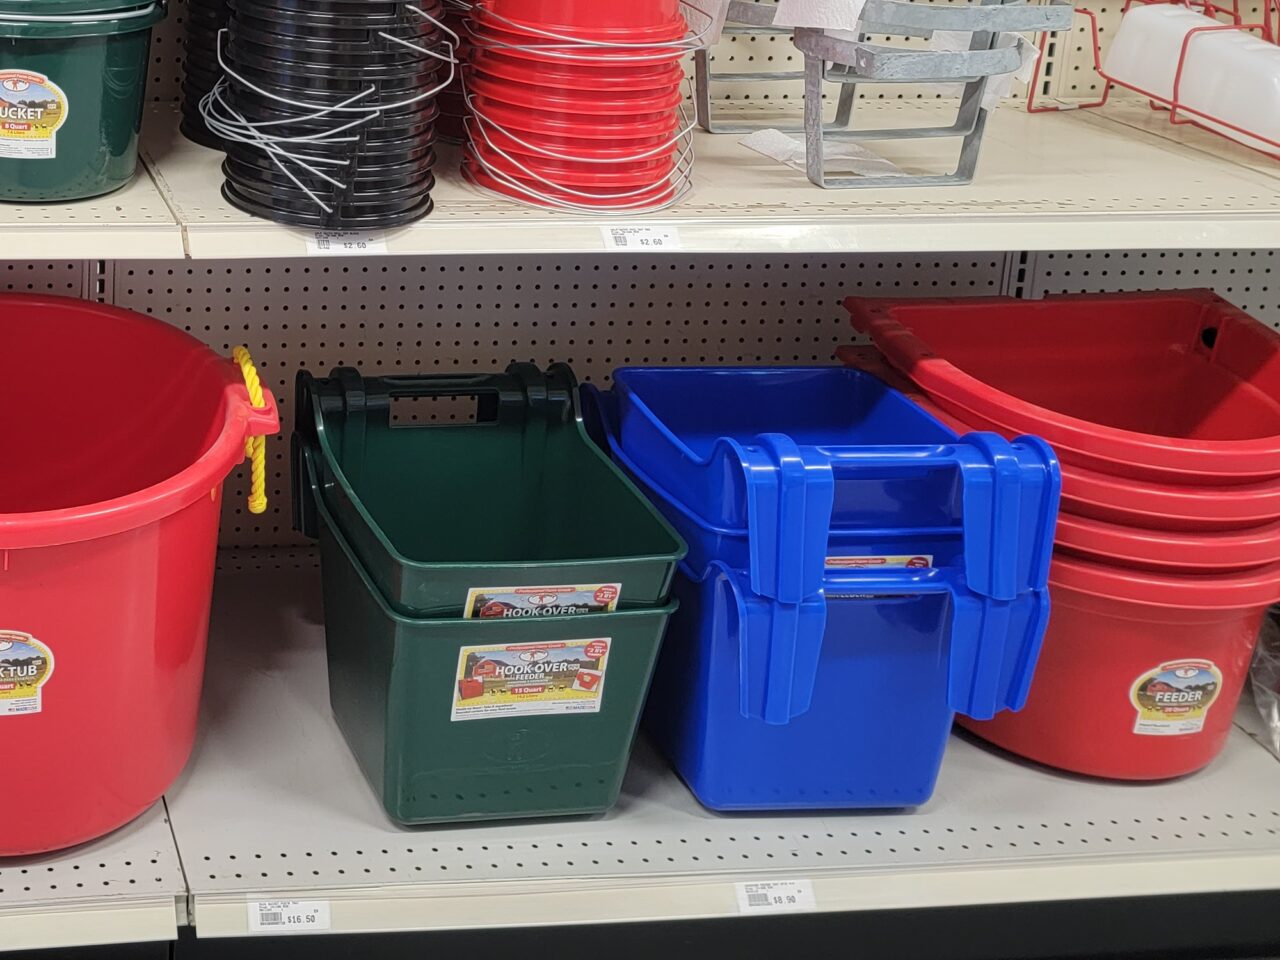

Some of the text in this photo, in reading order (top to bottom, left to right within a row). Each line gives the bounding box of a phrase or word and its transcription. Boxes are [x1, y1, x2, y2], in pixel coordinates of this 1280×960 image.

[503, 606, 576, 618] HOOK OVER
[8, 665, 37, 677] TUB
[496, 662, 568, 676] HOOK OVER
[1155, 691, 1203, 702] FEEDER
[287, 915, 316, 923] $16.50
